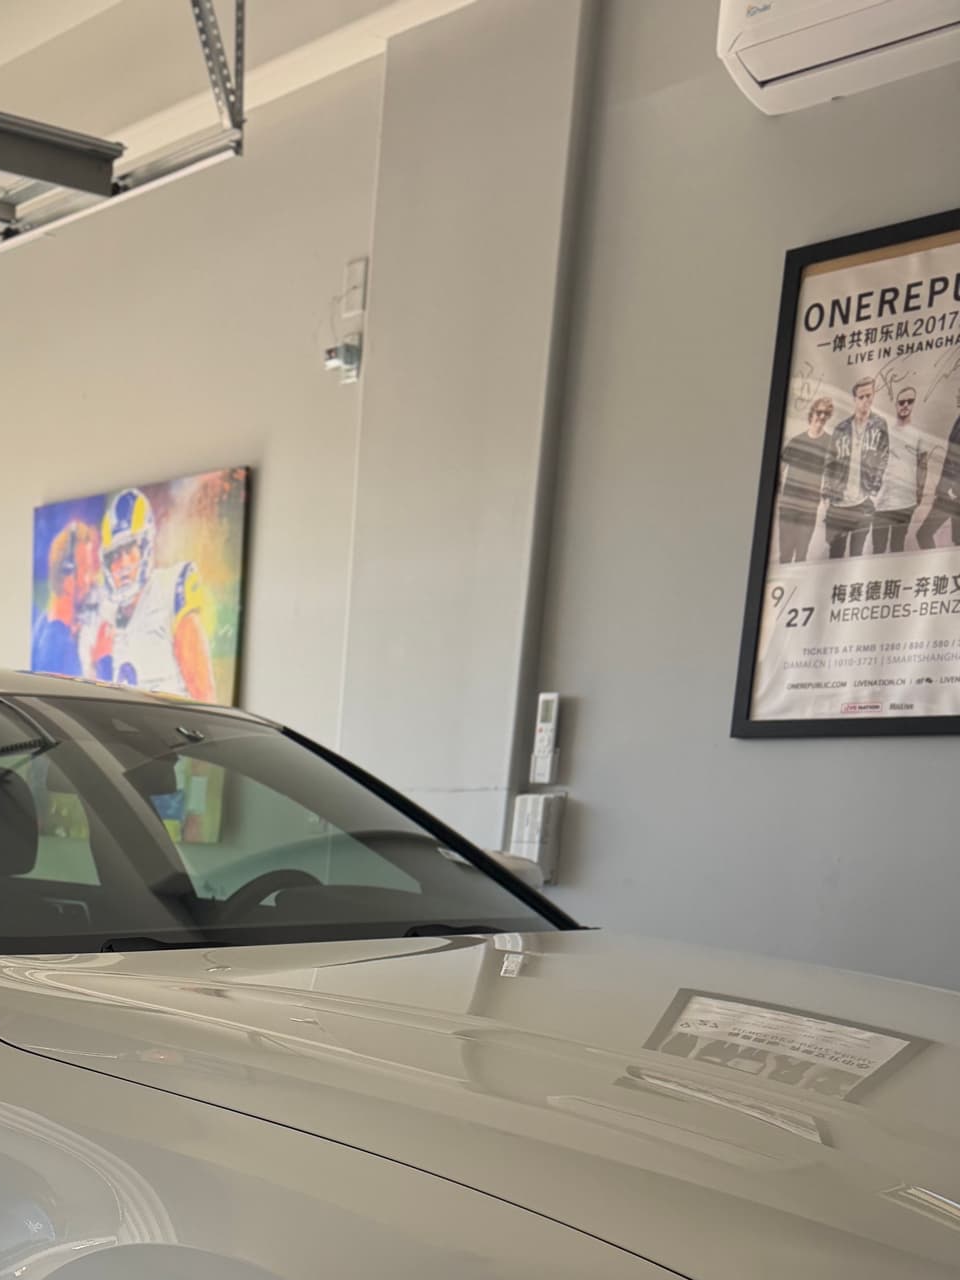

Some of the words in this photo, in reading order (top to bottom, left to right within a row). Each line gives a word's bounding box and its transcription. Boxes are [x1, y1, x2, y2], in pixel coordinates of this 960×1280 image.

[847, 350, 874, 366] LIVE
[878, 346, 891, 359] IN
[829, 599, 960, 623] MERCEDES-BENZ
